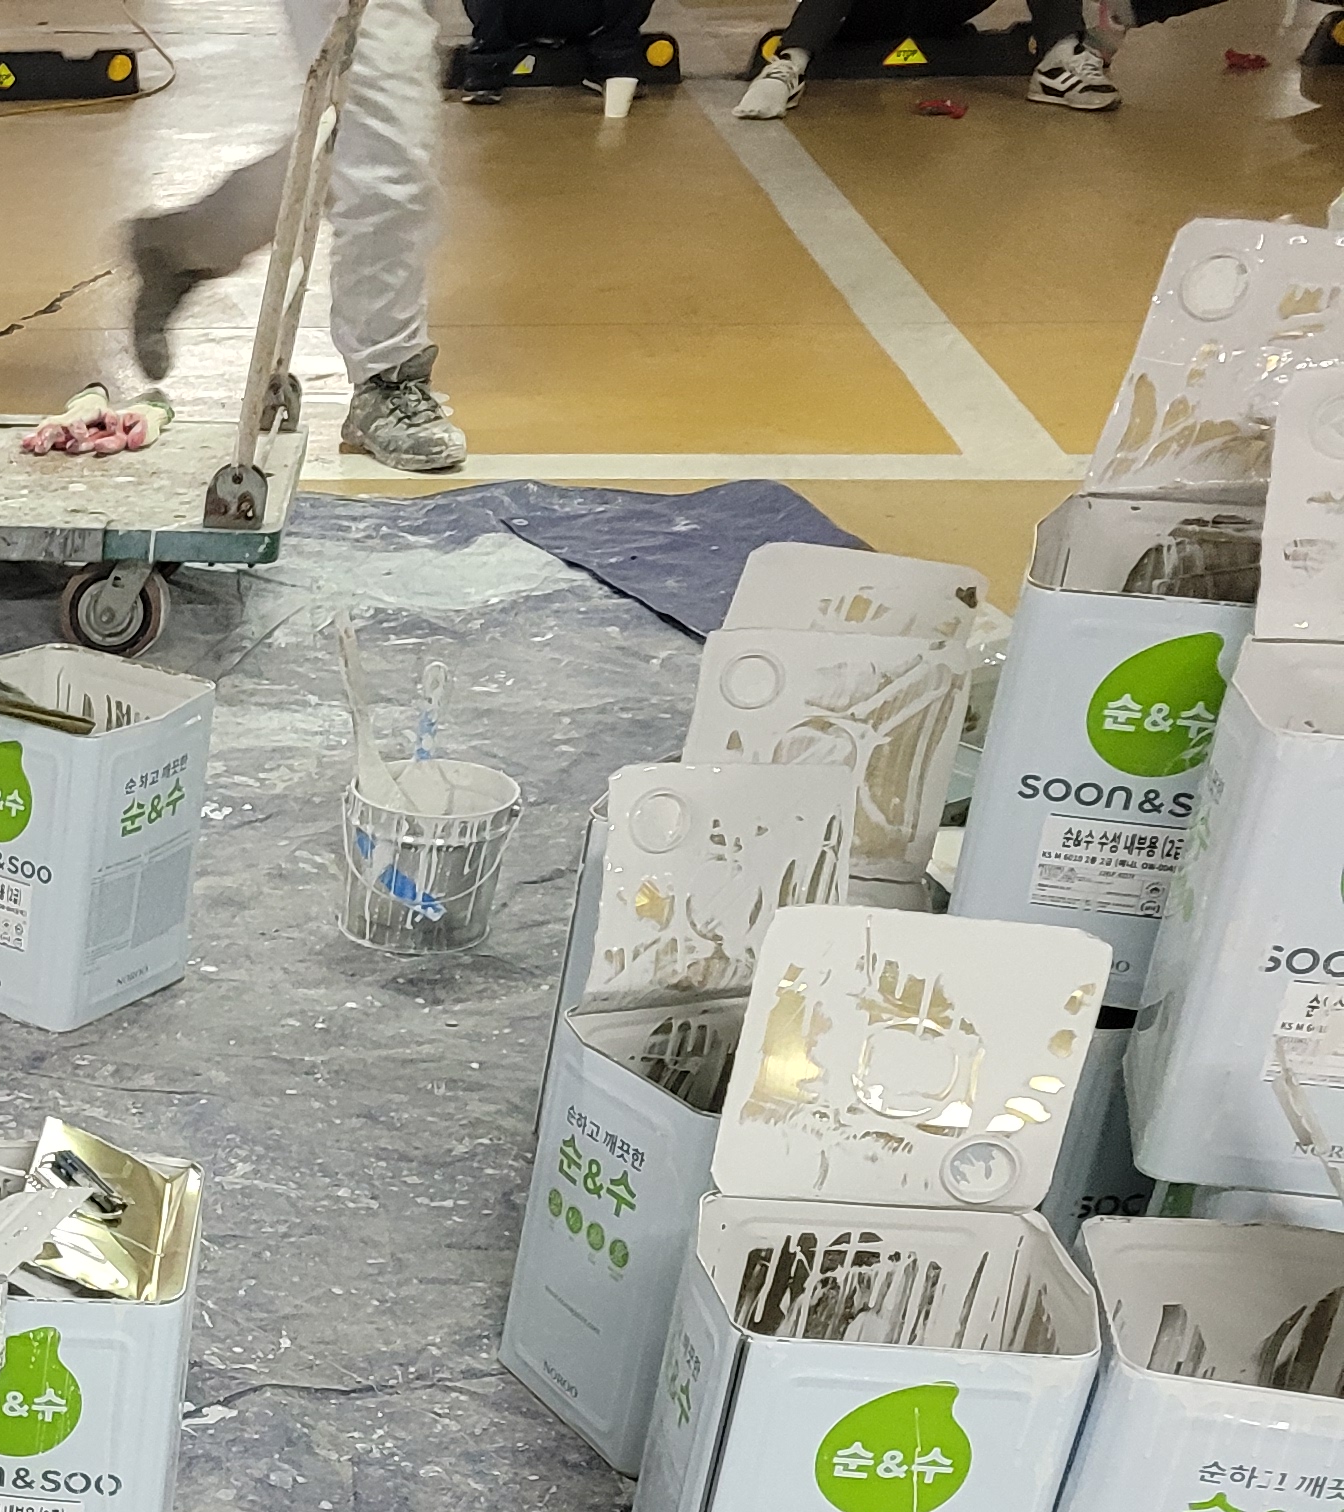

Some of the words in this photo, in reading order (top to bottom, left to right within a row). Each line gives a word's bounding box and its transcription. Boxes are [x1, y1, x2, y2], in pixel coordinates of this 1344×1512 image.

[120, 777, 185, 837] 순&수
[567, 1105, 600, 1142] 순하고
[602, 1130, 645, 1172] 깨끗한
[558, 1133, 636, 1218] 순&수
[832, 1441, 954, 1484] 순&수
[1199, 1461, 1288, 1492] 순하고
